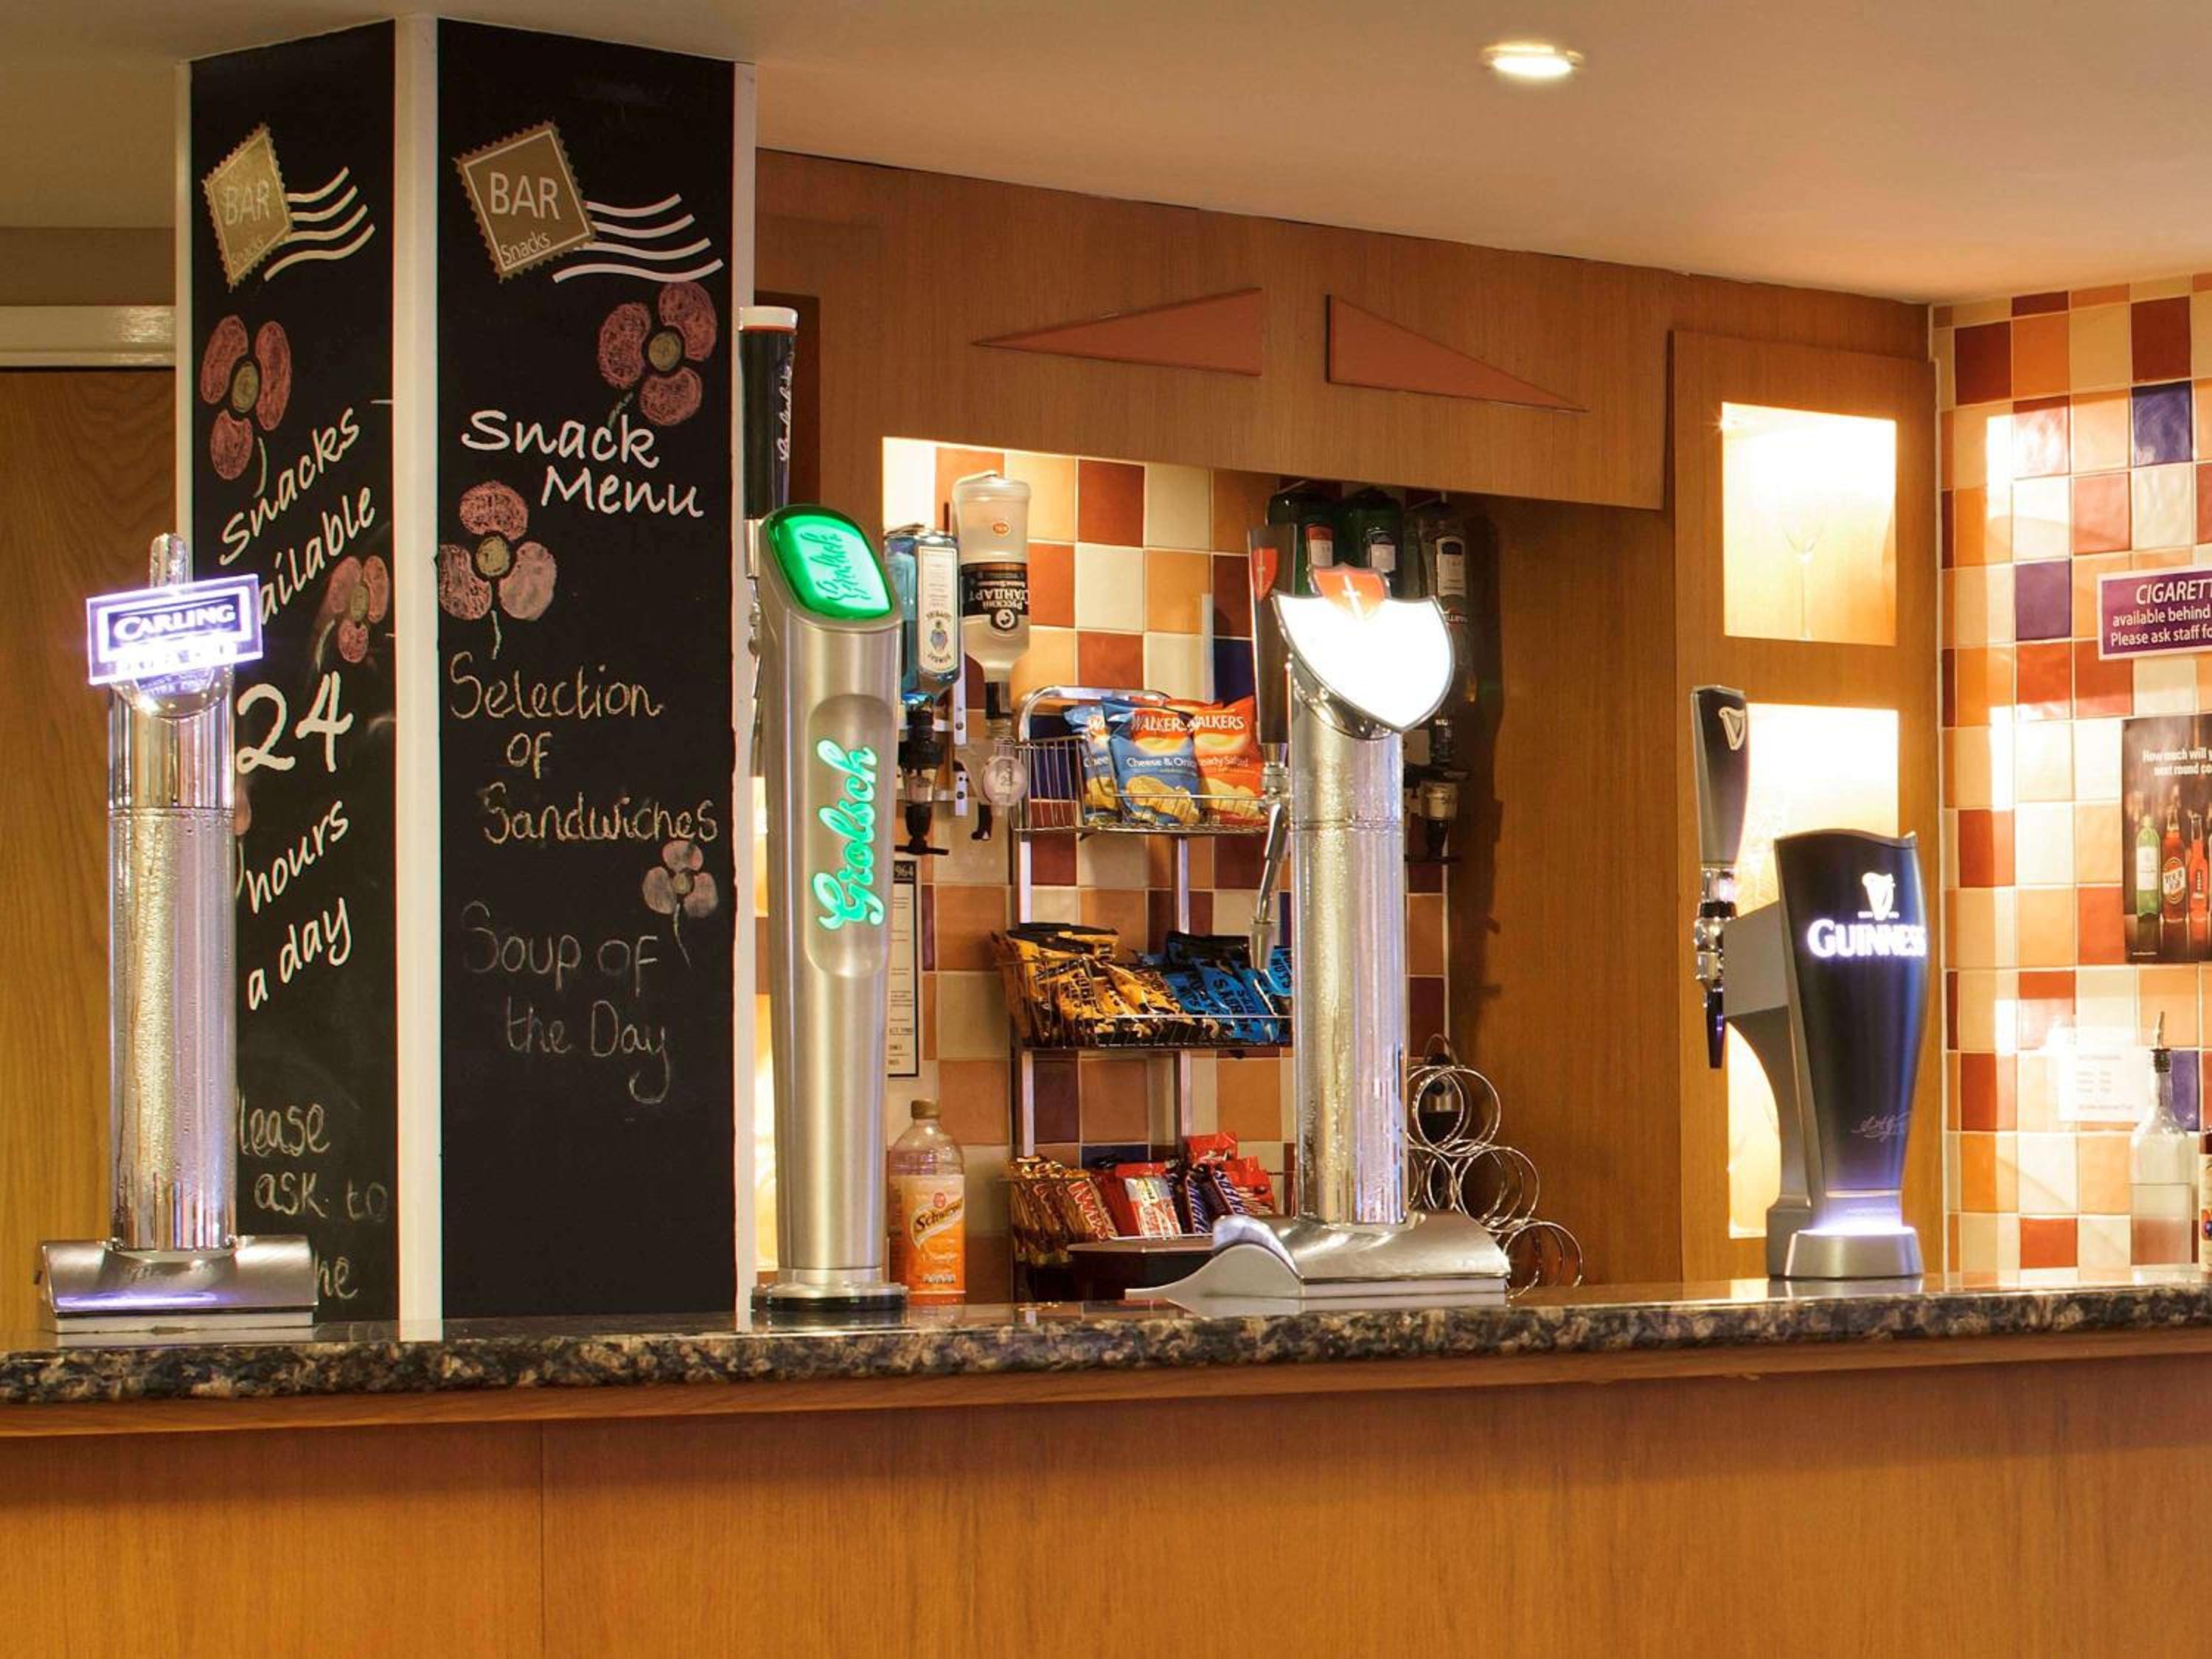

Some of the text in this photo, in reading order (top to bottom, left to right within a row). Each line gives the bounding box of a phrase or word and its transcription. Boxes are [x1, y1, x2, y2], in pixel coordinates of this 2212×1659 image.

[224, 181, 269, 224] BAR
[490, 172, 560, 220] BAR
[501, 231, 552, 265] Snacks
[461, 409, 660, 468] Snack
[220, 407, 361, 566] Snacks
[541, 465, 704, 518] Menu
[260, 487, 376, 625] ailable
[113, 604, 236, 641] CARLING
[2110, 623, 2212, 647] Please ask staff fo
[2112, 604, 2211, 627] available behind
[450, 650, 664, 719] Selection
[236, 670, 354, 774] 24
[1173, 757, 1197, 768] Onio
[2188, 746, 2207, 759] will
[483, 782, 718, 844] Sandwiches
[813, 740, 884, 930] Grolsch
[246, 801, 349, 914] hours
[895, 864, 914, 877] 964
[248, 897, 352, 1011] a day
[461, 900, 582, 992] Soup
[507, 995, 672, 1104] the Day
[237, 1094, 331, 1158] lease
[254, 1171, 388, 1222] ask to
[315, 1251, 358, 1299] he
